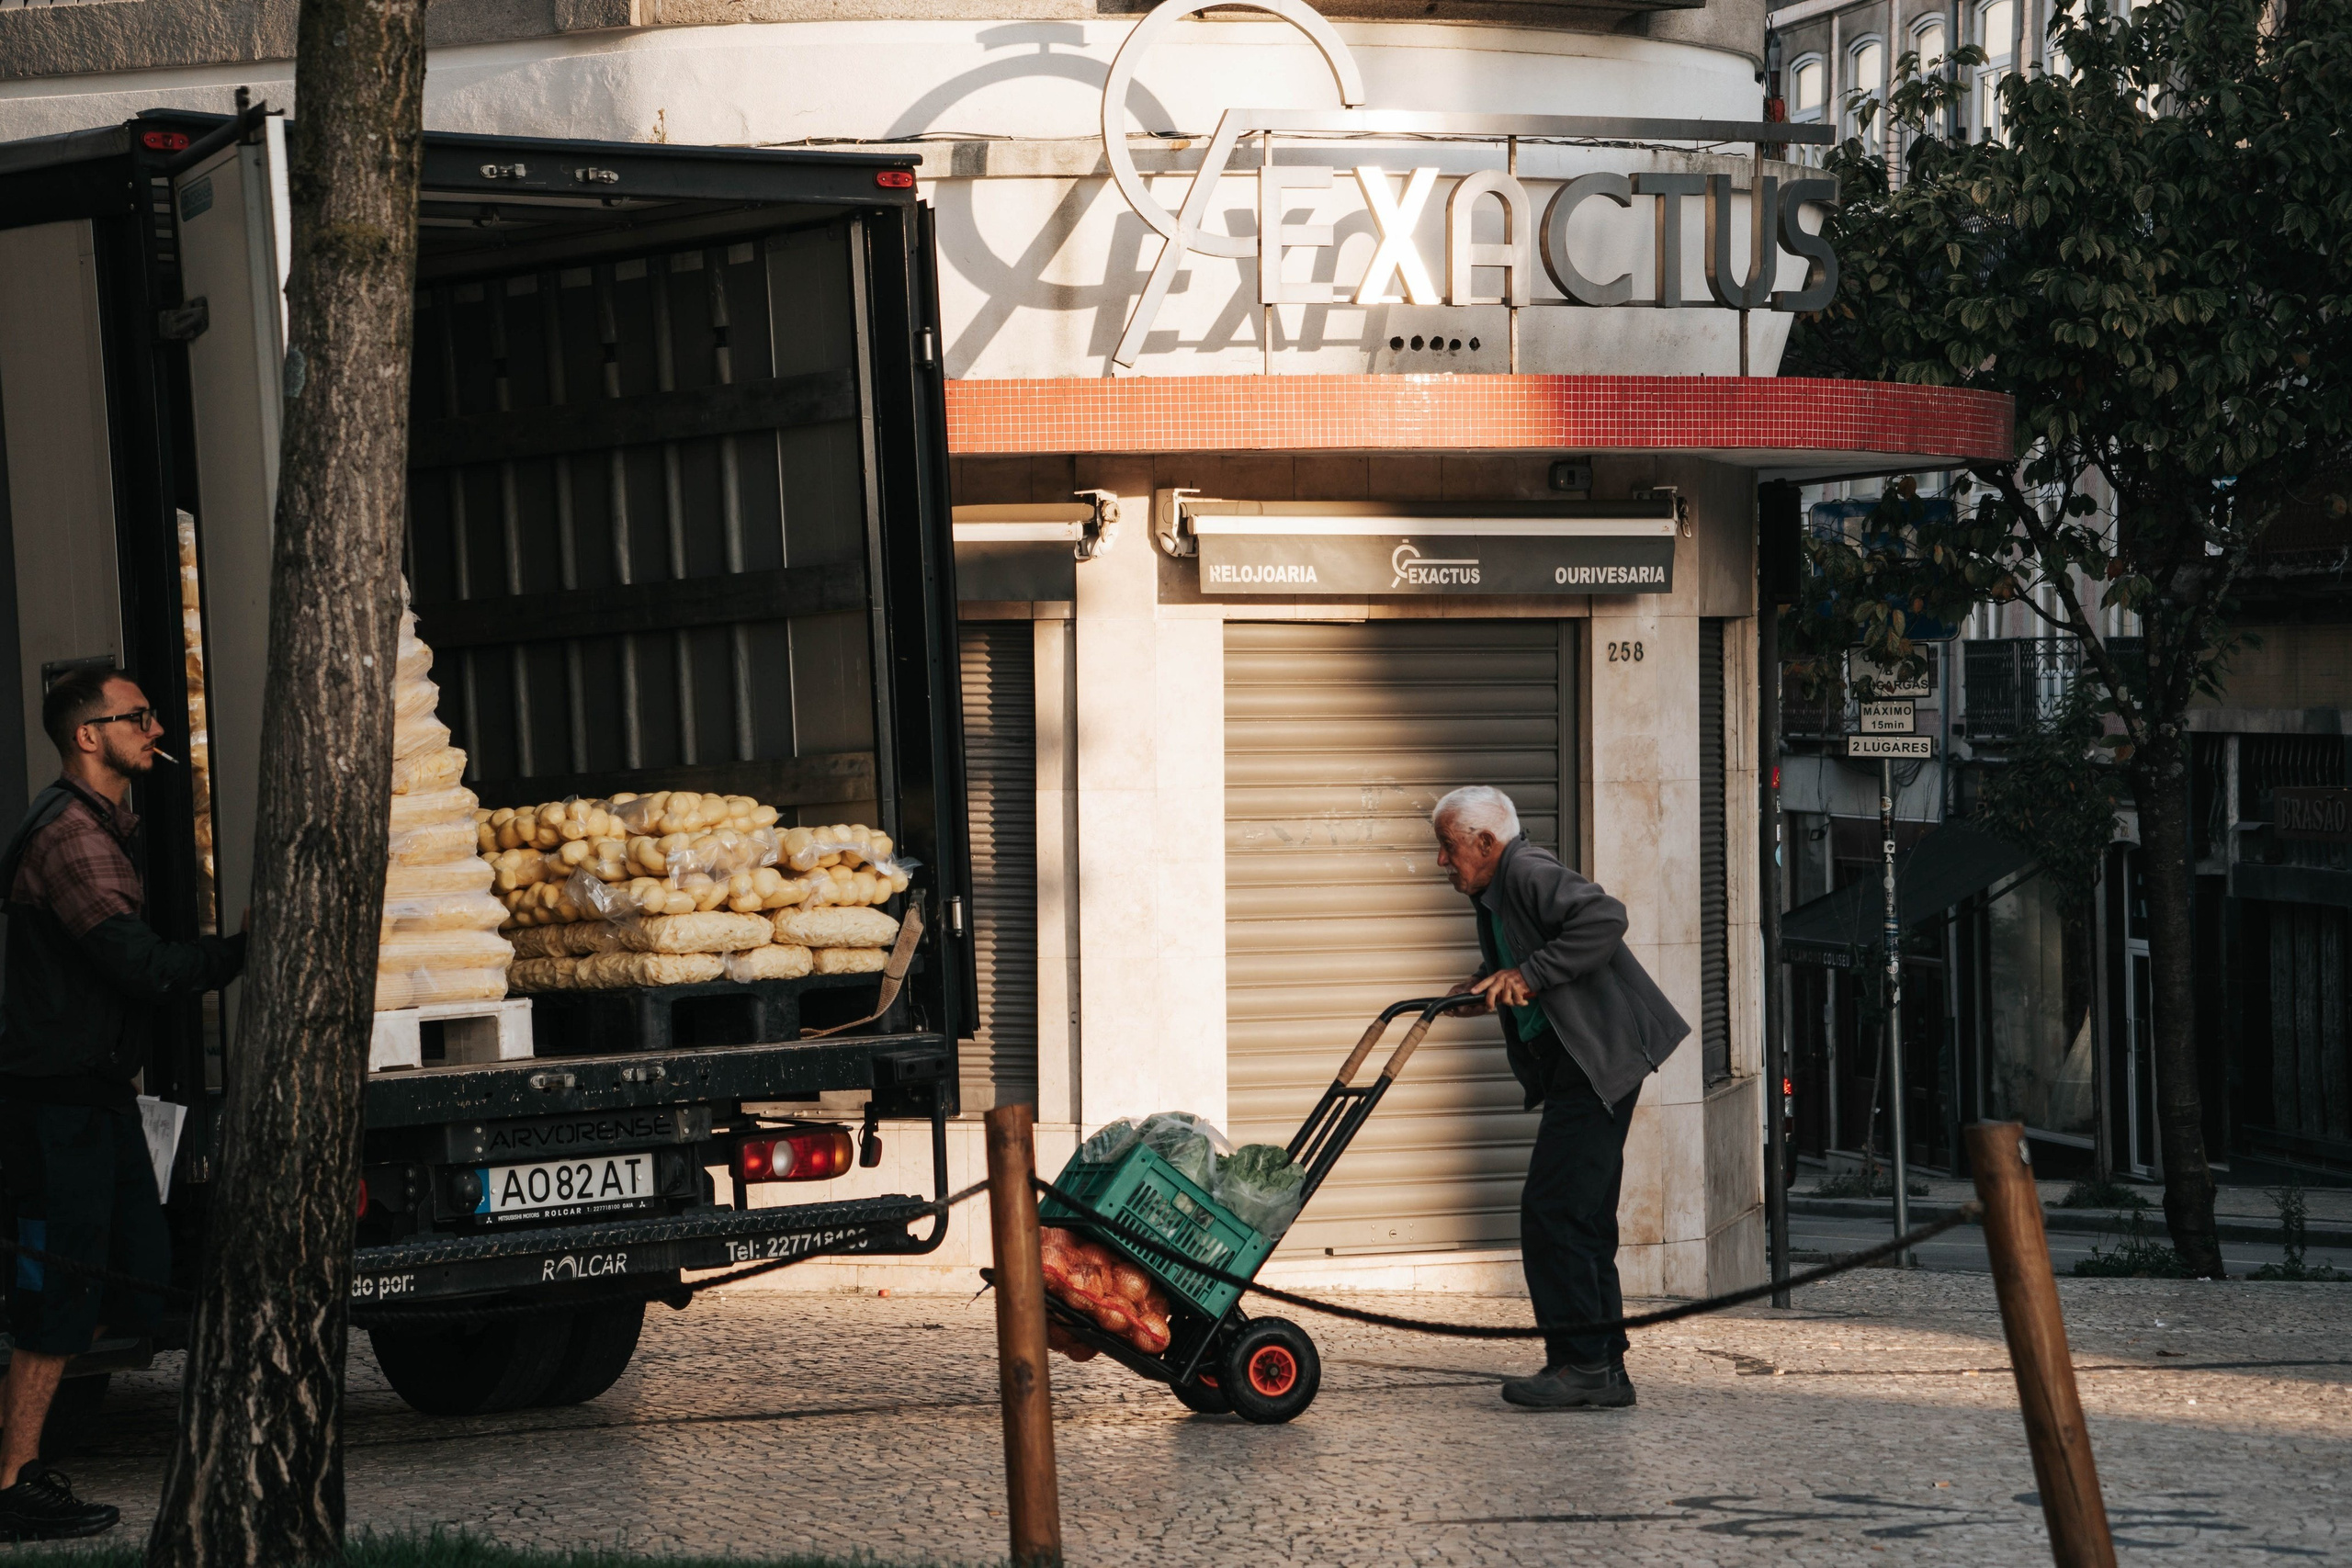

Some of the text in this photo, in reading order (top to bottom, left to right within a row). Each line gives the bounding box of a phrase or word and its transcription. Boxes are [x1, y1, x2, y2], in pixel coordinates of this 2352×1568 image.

[1258, 165, 1838, 312] EXACTUS
[1209, 564, 1317, 584] RELOJOARIA
[1408, 567, 1481, 585] EXACTUS
[1555, 565, 1666, 584] OURIVESARIA
[1607, 641, 1645, 662] 258
[1863, 705, 1912, 716] MÁXIMO
[1871, 721, 1905, 729] 15min
[1852, 741, 1928, 752] 2 LUGARES
[2280, 795, 2346, 832] BRASÃO
[1823, 952, 1850, 968] COLISEU
[489, 1117, 672, 1151] ARVORENSE
[498, 1213, 522, 1222] MITSUBISHI
[544, 1207, 582, 1218] ROLCAR
[594, 1204, 620, 1213] 227718100
[725, 1239, 761, 1262] Tel:
[379, 1273, 415, 1301] por:
